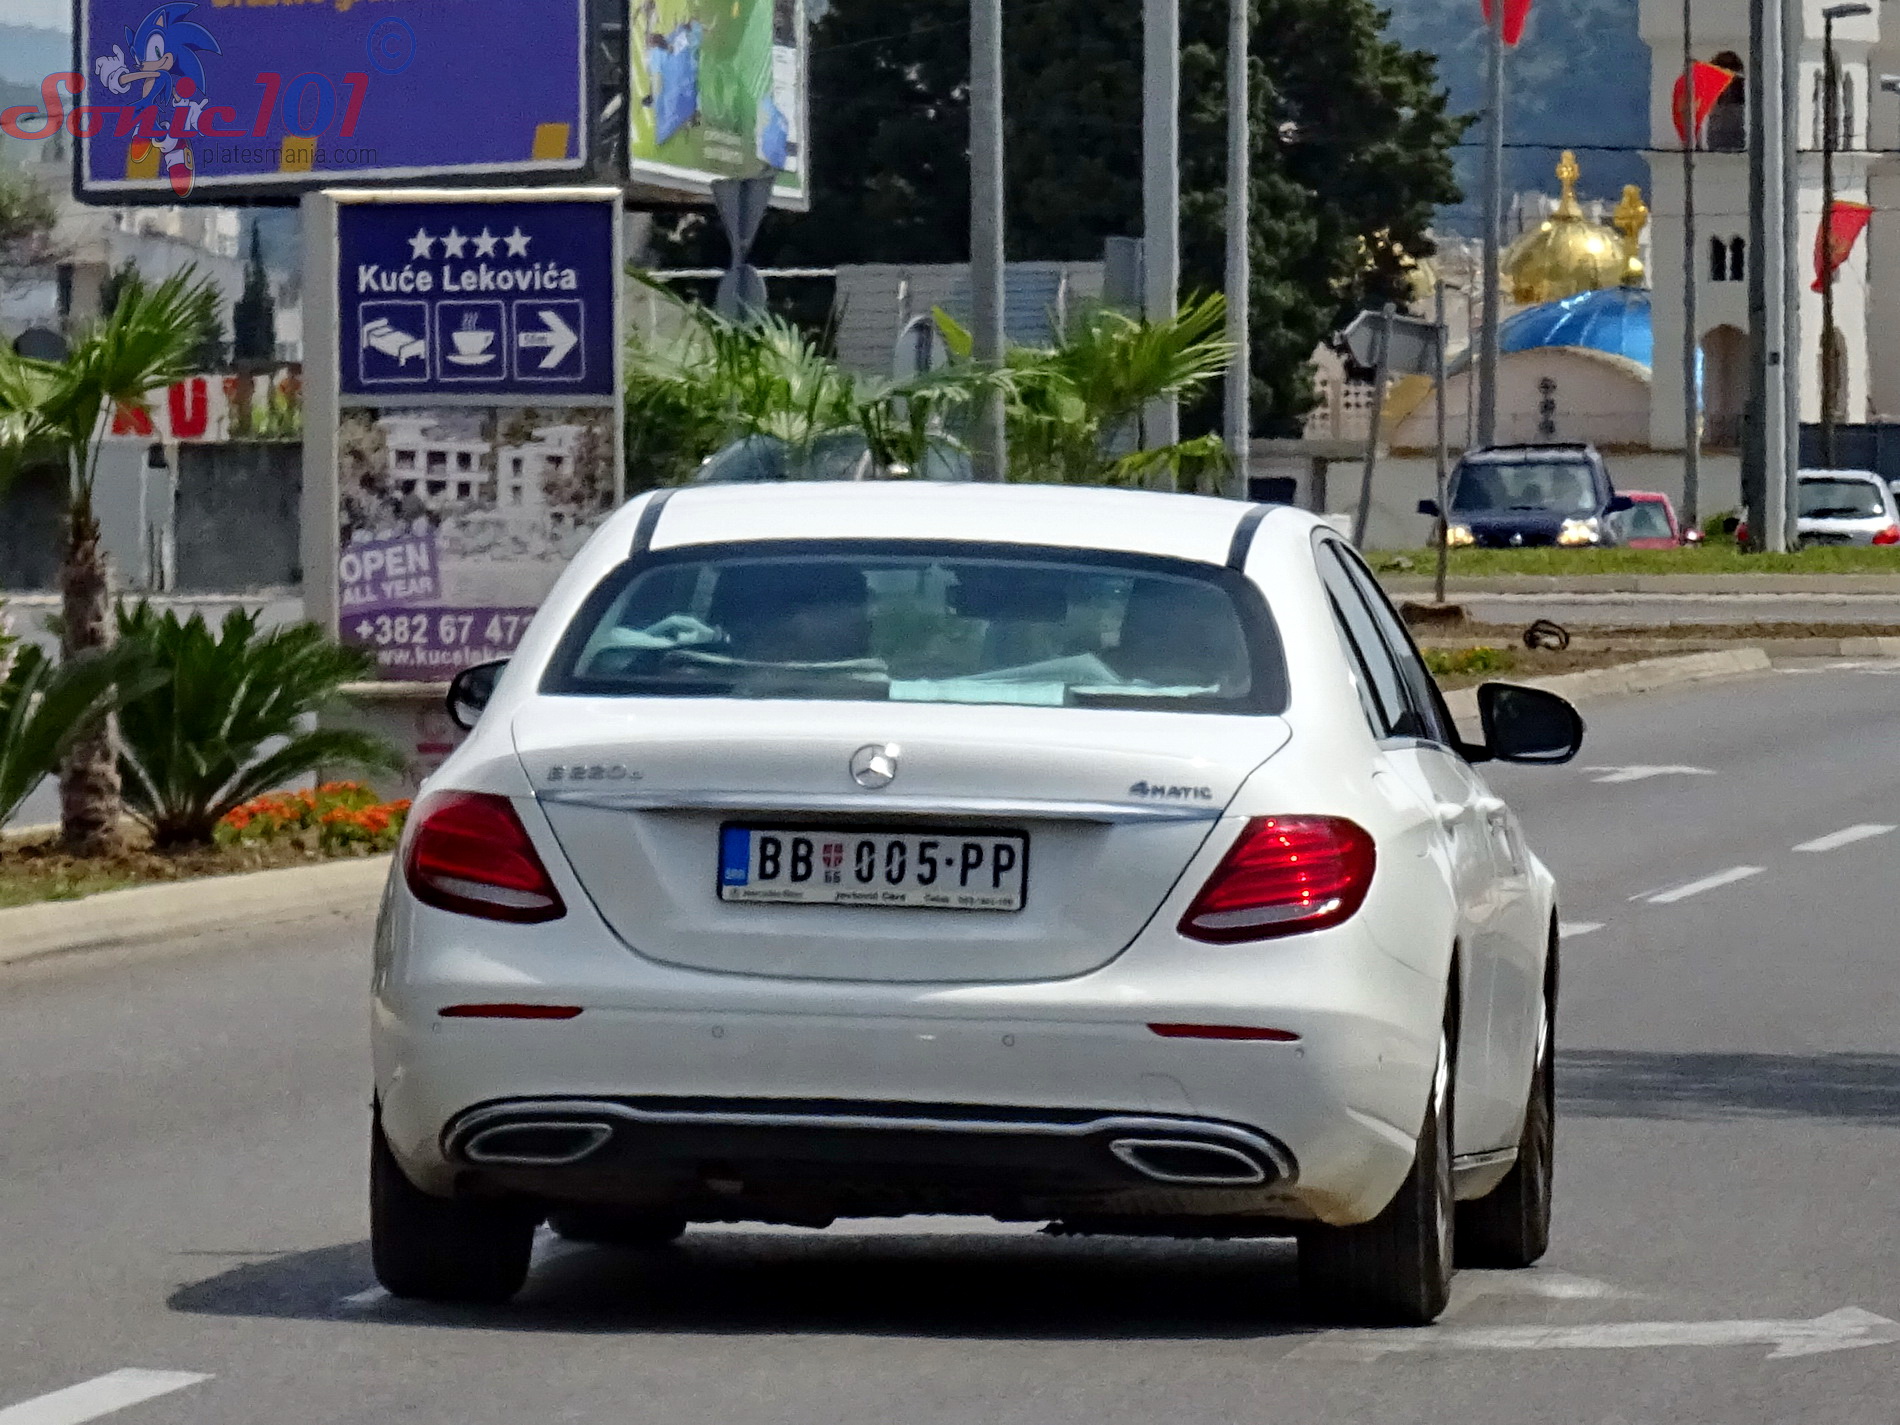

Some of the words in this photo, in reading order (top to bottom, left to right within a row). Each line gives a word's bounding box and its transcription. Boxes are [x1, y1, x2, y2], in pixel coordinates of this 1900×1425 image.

[358, 263, 433, 293] Kuće
[443, 262, 578, 292] Lekovića
[339, 541, 431, 584] OPEN
[343, 584, 379, 605] ALL
[381, 576, 433, 600] YEAR
[355, 614, 429, 645] +382
[439, 614, 475, 645] 67
[484, 614, 536, 645] 47
[1128, 779, 1213, 799] 4MATIC
[758, 836, 814, 882] BB
